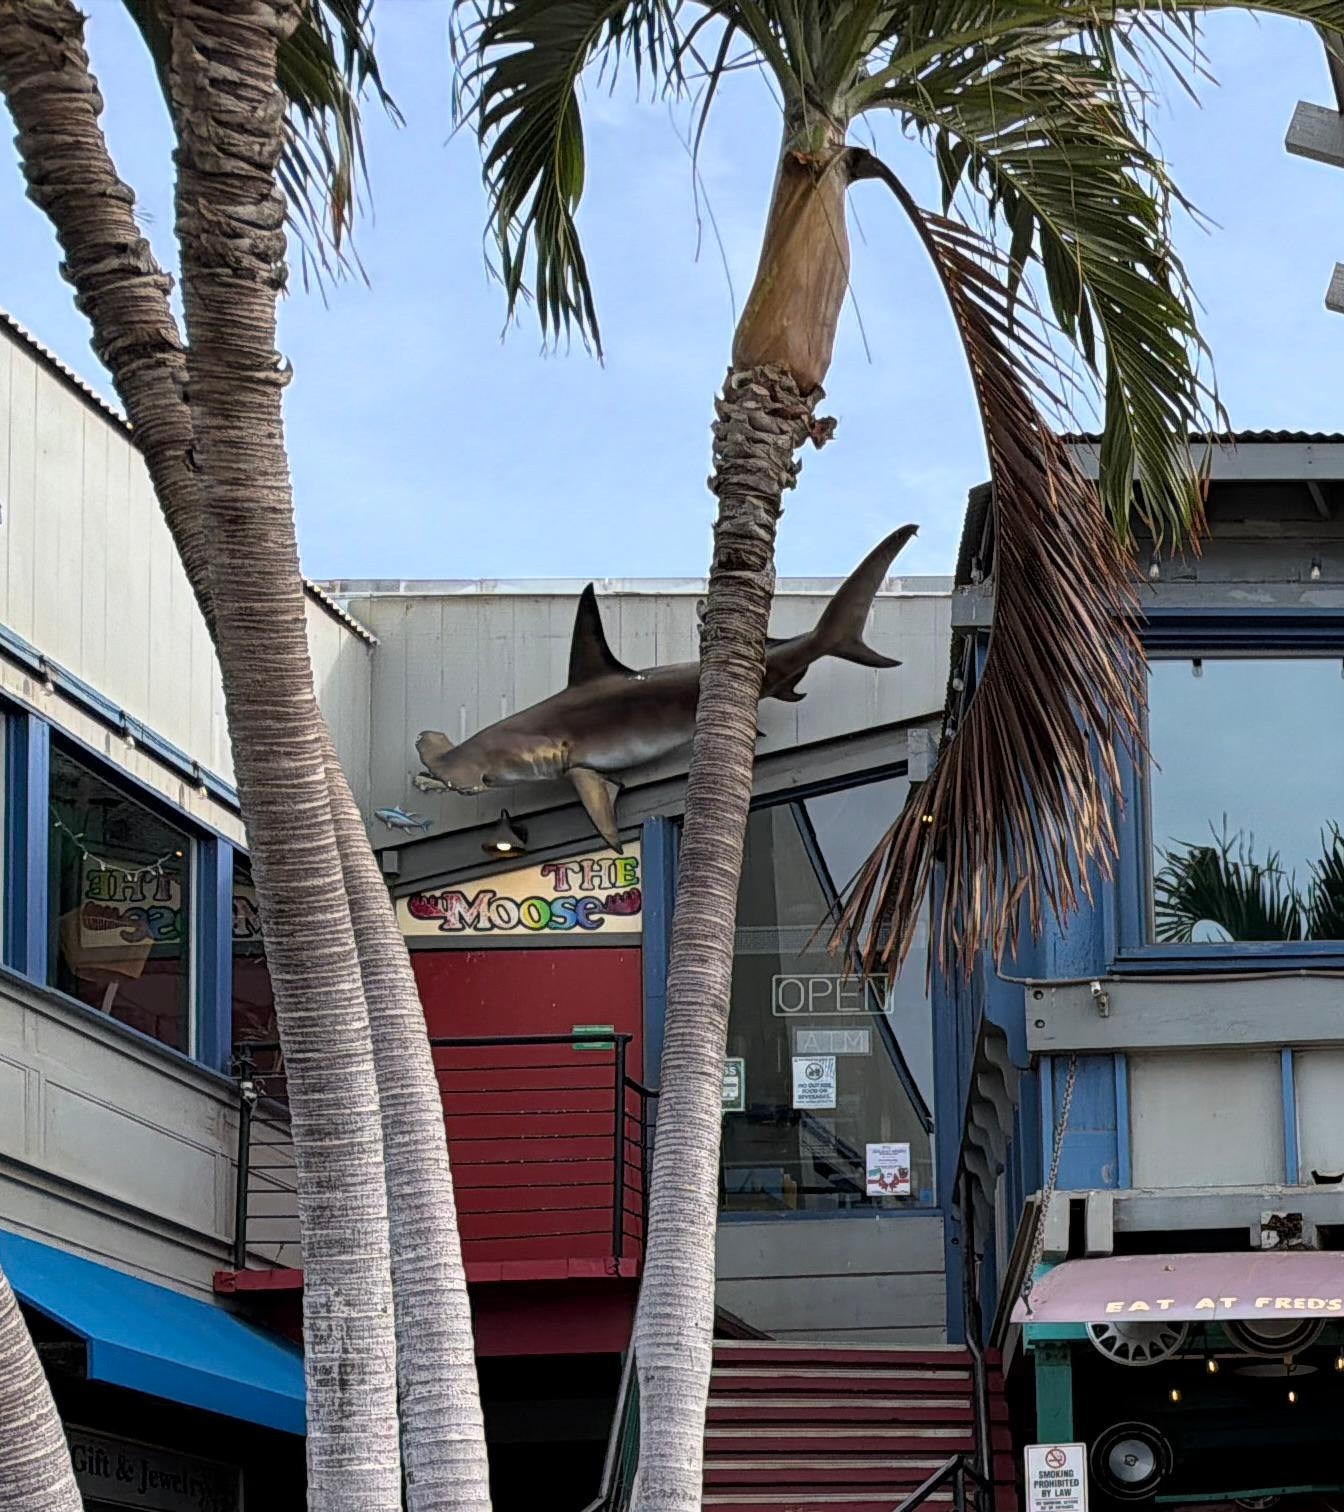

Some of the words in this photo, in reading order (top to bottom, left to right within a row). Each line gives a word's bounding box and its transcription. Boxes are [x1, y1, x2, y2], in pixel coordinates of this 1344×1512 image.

[541, 857, 640, 893] THE
[438, 889, 605, 931] Moose
[777, 976, 890, 1014] OPEN
[1105, 1299, 1176, 1313] EAT
[1194, 1297, 1238, 1309] AT
[1254, 1297, 1344, 1311] FRED'S
[115, 1454, 134, 1482] &
[1038, 1469, 1074, 1479] SMOKING
[1033, 1478, 1080, 1488] PROHIBITED
[1041, 1489, 1052, 1498] BY
[1055, 1488, 1072, 1497] LAW
